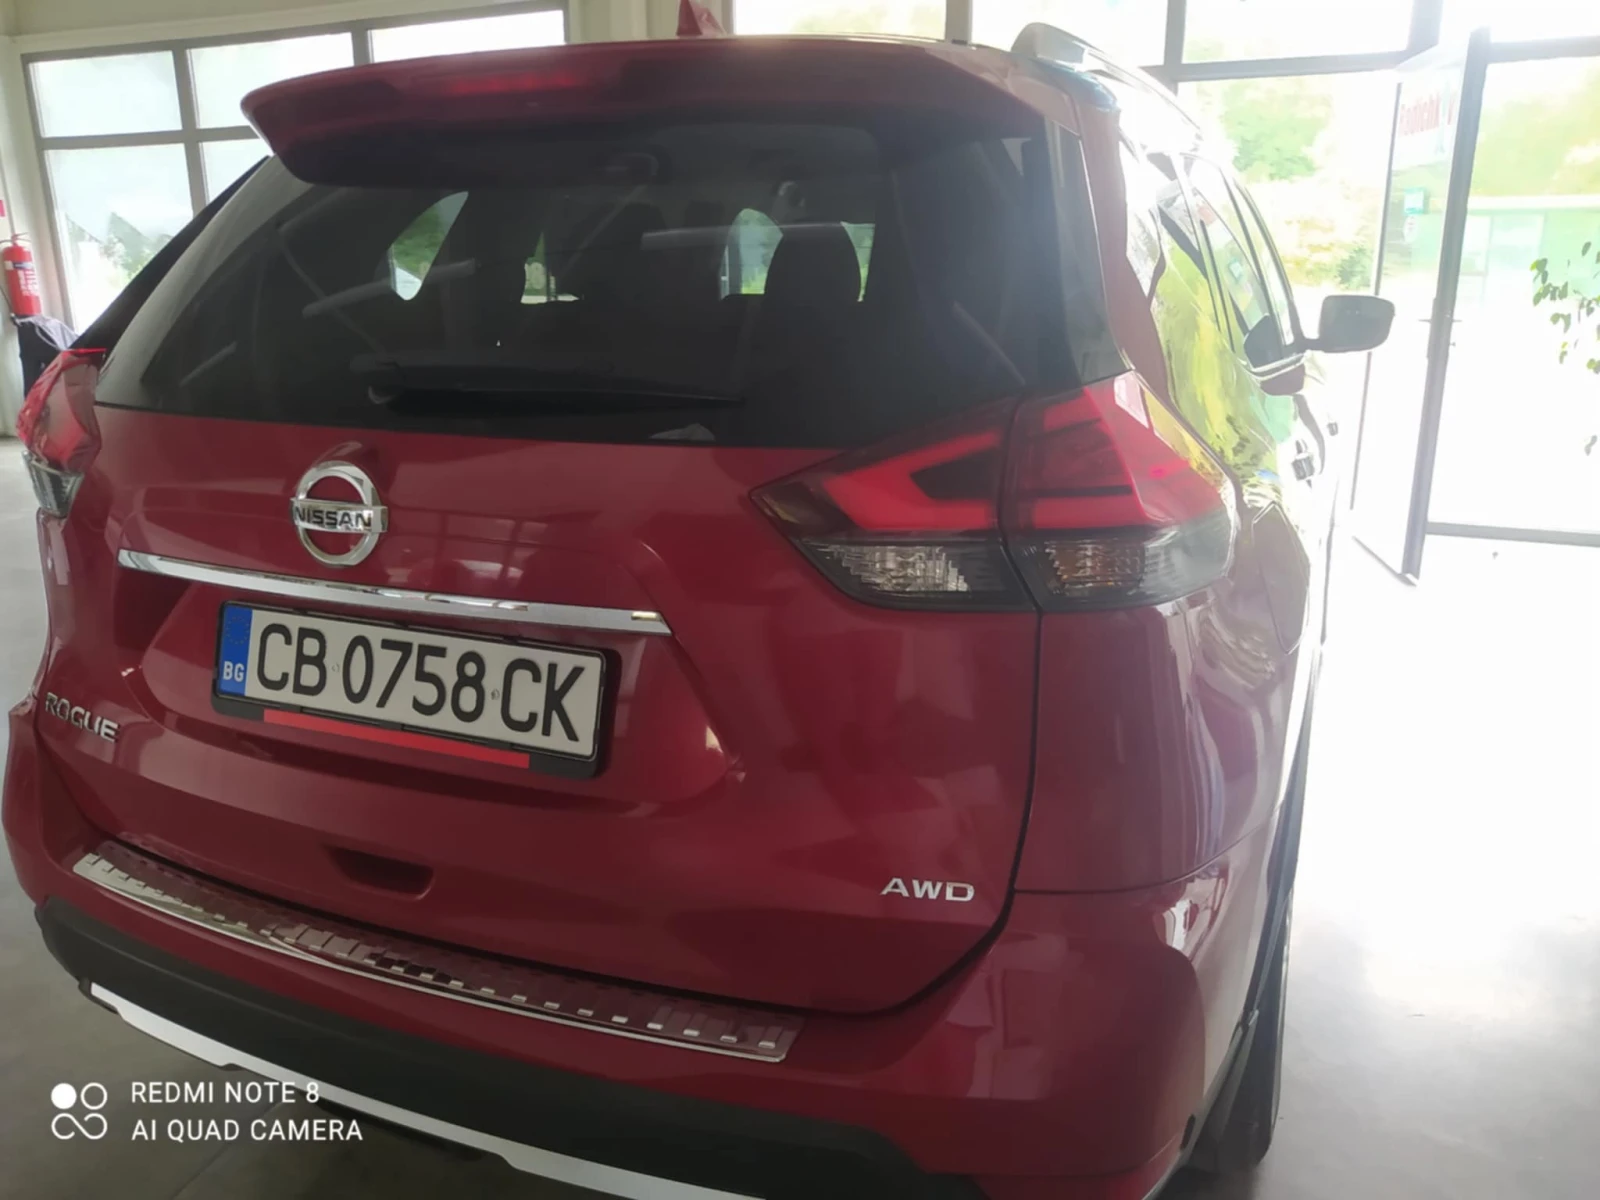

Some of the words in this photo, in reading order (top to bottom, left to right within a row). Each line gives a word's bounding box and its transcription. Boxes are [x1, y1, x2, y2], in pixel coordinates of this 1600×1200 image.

[294, 506, 372, 528] NISSAN
[222, 660, 245, 683] BG
[256, 622, 328, 697] CB
[342, 634, 487, 723] 0758
[501, 658, 585, 742] CK
[45, 691, 119, 743] ROGUE
[880, 877, 975, 902] AWD
